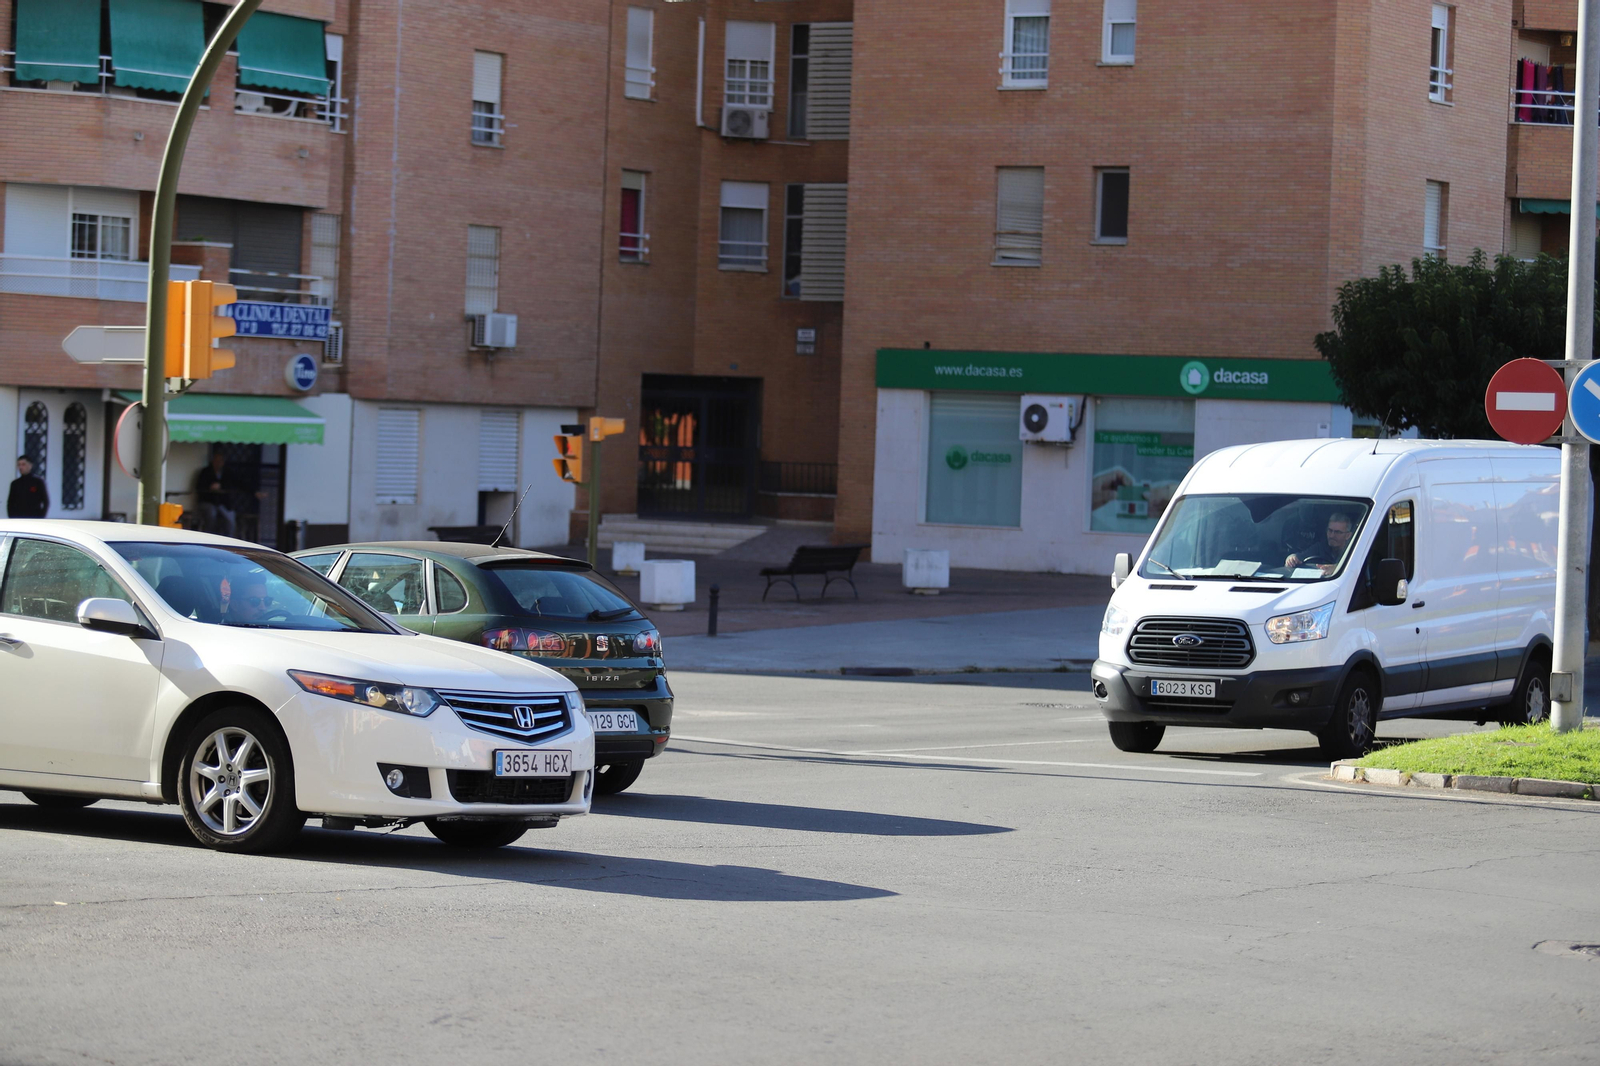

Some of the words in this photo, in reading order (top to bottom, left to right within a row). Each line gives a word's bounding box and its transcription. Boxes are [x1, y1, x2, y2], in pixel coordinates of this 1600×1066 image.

[235, 304, 281, 322] CLINICA
[283, 307, 328, 324] DENTAL
[934, 363, 1024, 378] www.dacasa.es
[1213, 367, 1269, 385] dacasa
[1099, 433, 1108, 442] Te
[1110, 434, 1151, 445] ayudamos
[970, 450, 1012, 464] dacasa
[1138, 447, 1166, 455] vender
[1167, 447, 1176, 456] tu
[1158, 682, 1187, 694] 6023
[1190, 684, 1212, 696] KSG
[616, 714, 636, 729] GCH
[504, 754, 538, 773] 3654
[544, 754, 569, 773] HCX
